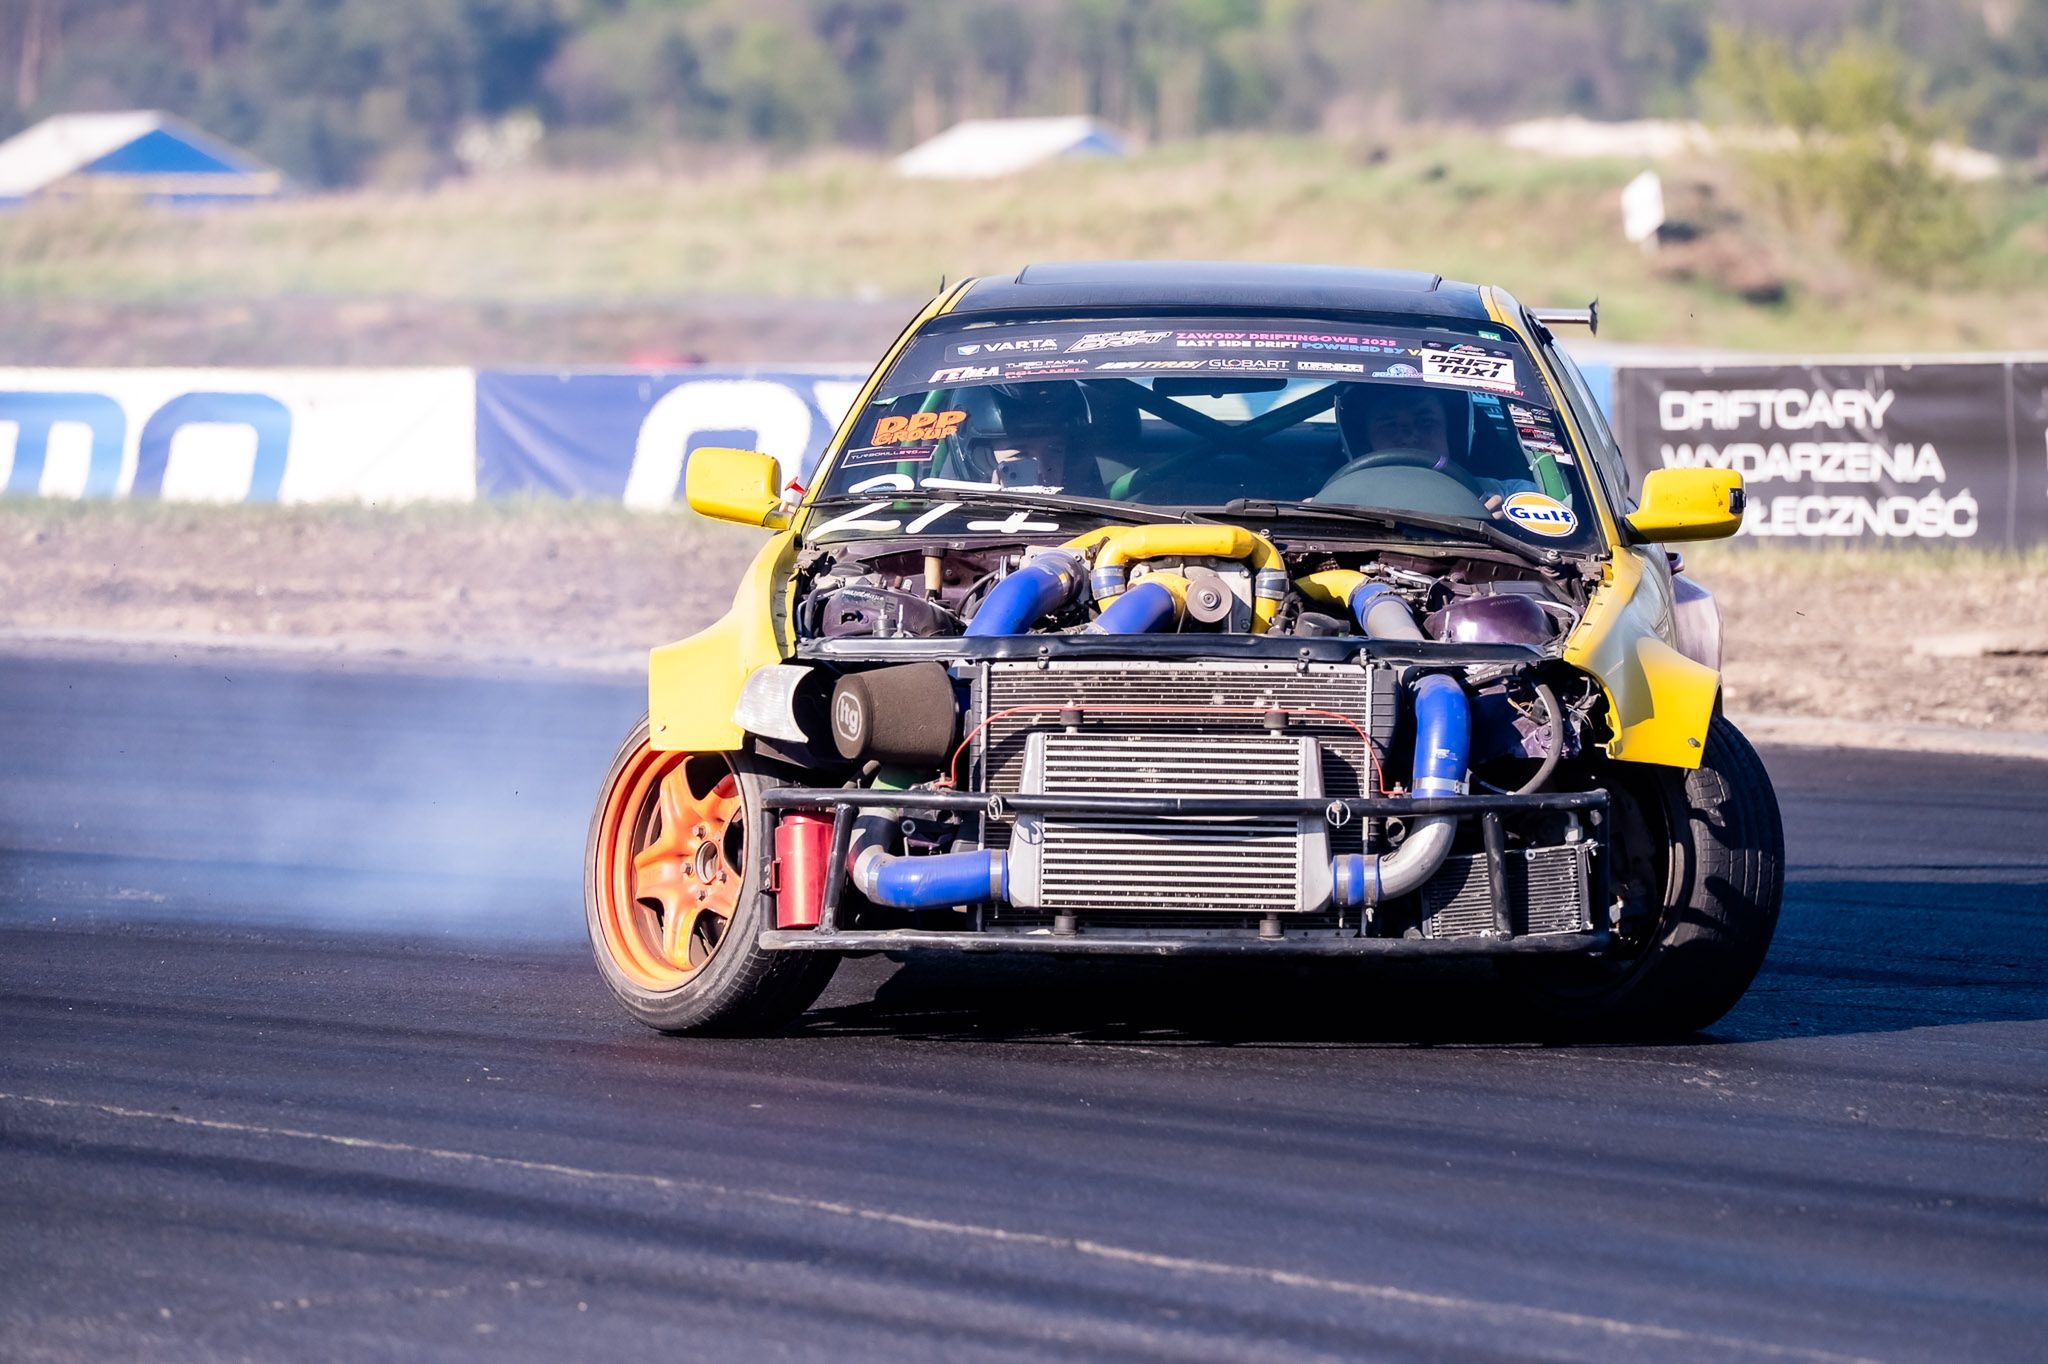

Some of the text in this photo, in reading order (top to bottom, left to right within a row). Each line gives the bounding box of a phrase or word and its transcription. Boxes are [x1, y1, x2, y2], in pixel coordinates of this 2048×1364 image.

[984, 339, 1058, 352] VARTA
[1176, 332, 1396, 347] ZAWODY DRIFTINGOWE 2025
[1218, 340, 1252, 348] SIDE
[1255, 341, 1300, 349] DRIFT
[1302, 342, 1380, 353] POWERED
[1208, 359, 1290, 369] GLOBART
[1428, 355, 1507, 370] DRIFT
[1437, 364, 1500, 378] TAXI
[1659, 388, 1895, 430] DRIFTCARY
[878, 410, 967, 435] DPP
[872, 426, 958, 446] GROUP
[1661, 442, 1946, 483] WYDARZENIA
[1509, 507, 1572, 523] Gulf
[1737, 487, 1979, 538] ŁECZNOŚĆ
